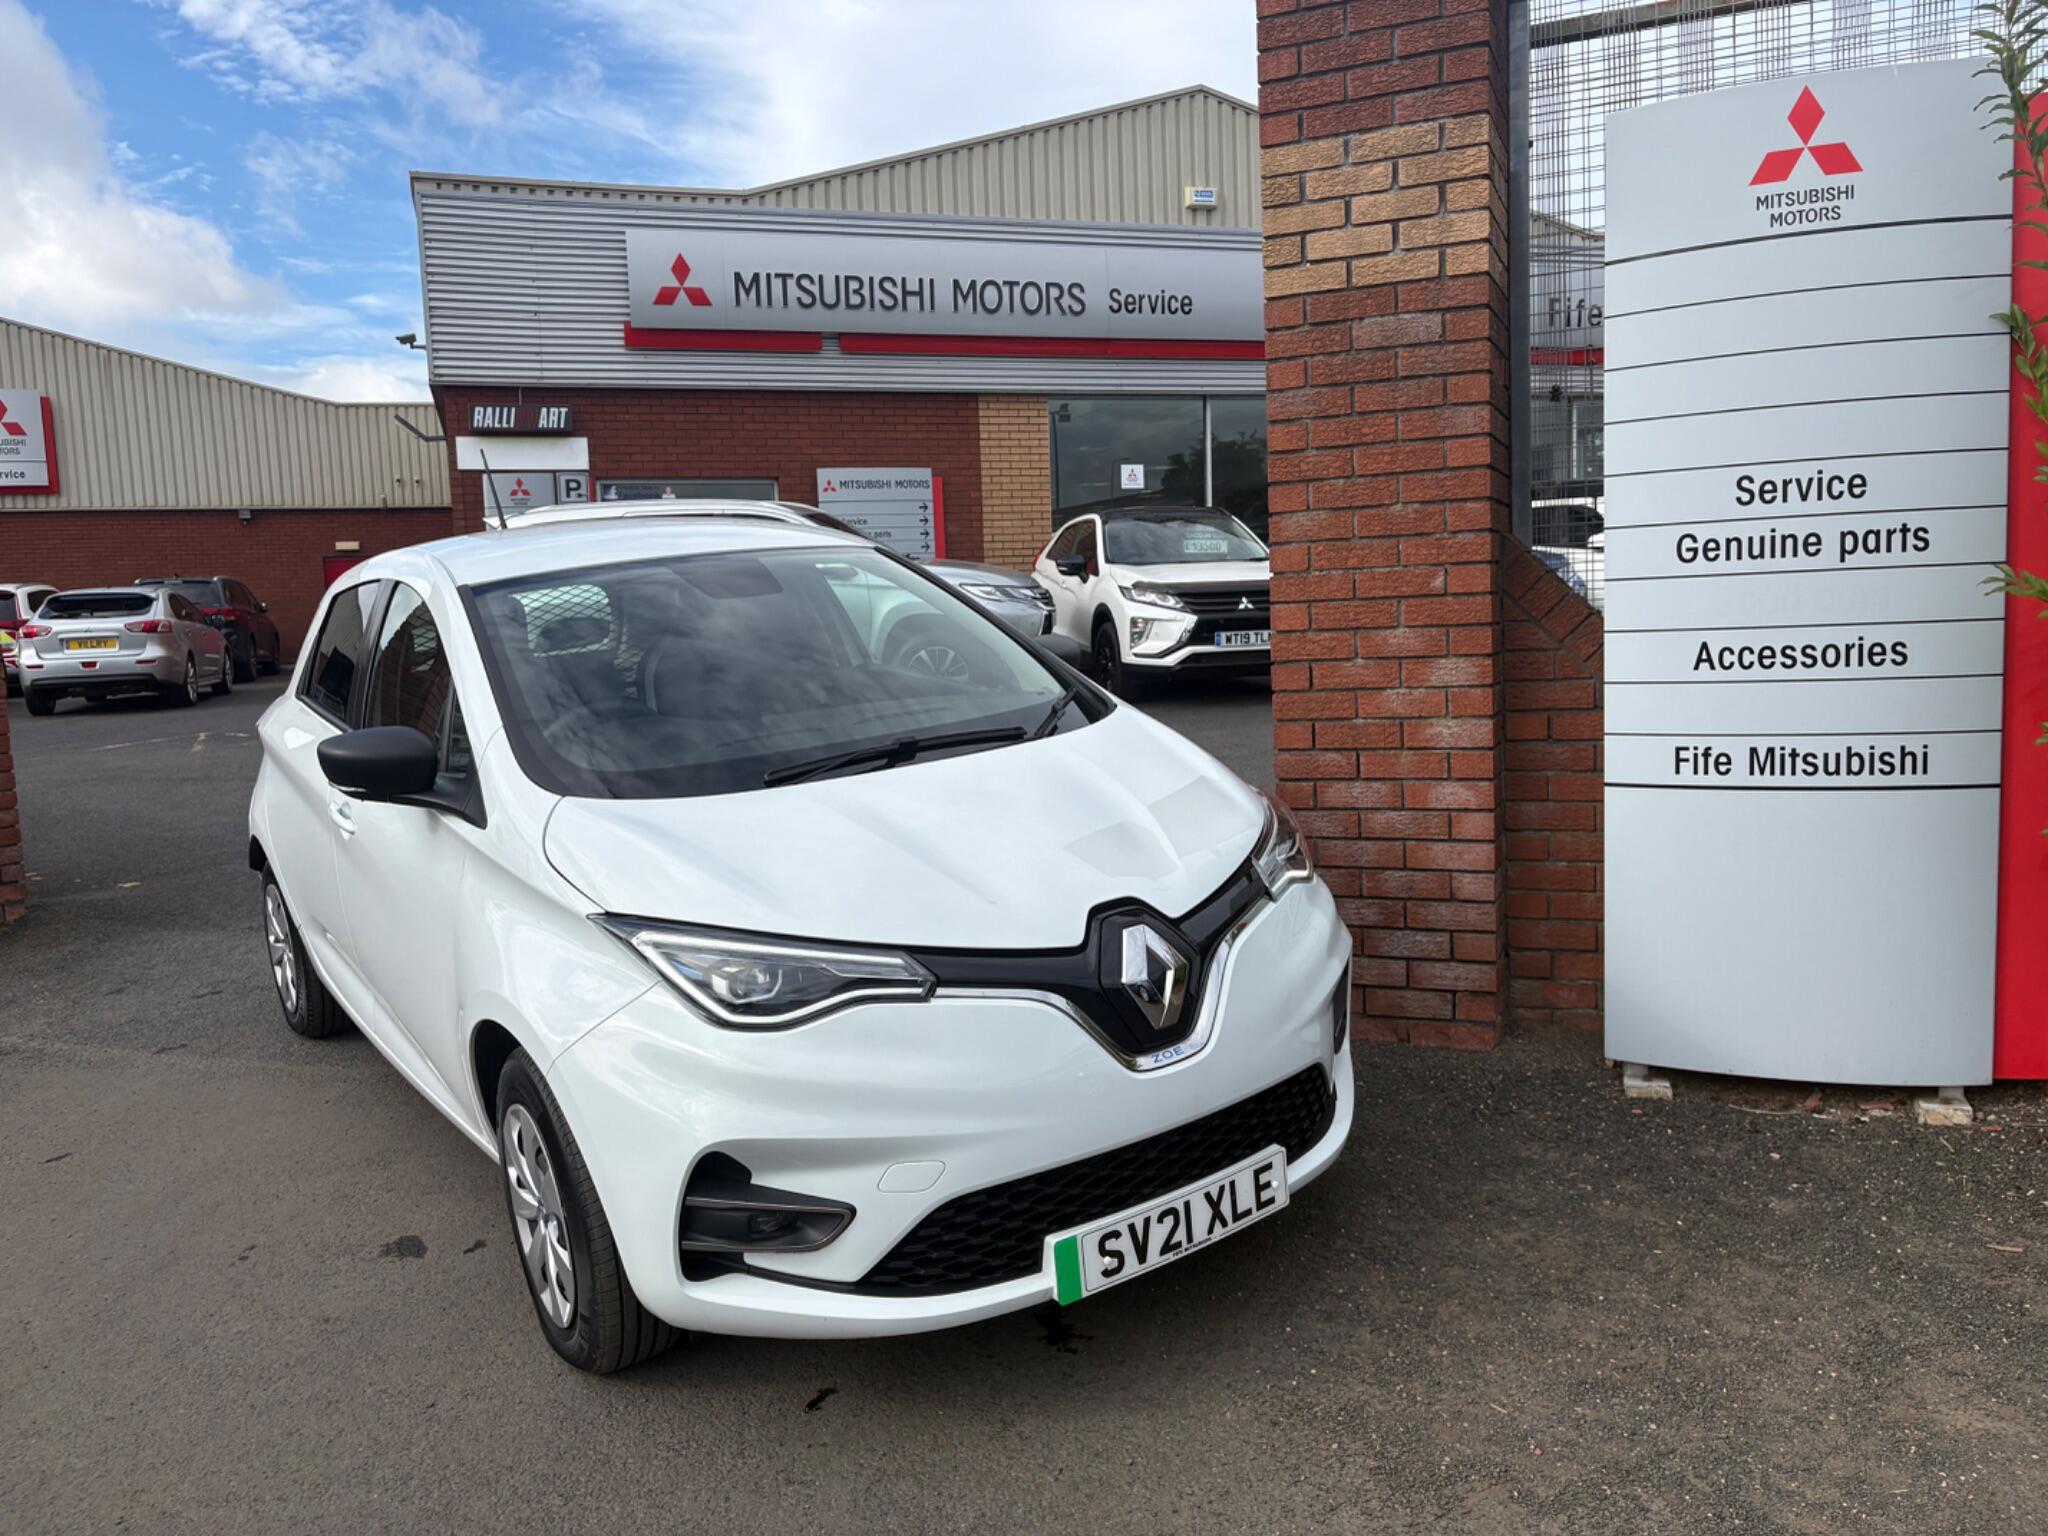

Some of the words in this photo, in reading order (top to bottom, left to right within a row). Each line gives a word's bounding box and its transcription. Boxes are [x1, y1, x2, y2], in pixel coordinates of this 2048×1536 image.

[1756, 184, 1855, 211] MITSUBISHI
[1770, 205, 1841, 228] MOTORS
[733, 270, 935, 312] MITSUBISHI
[952, 278, 1086, 317] MOTORS
[1108, 287, 1193, 315] Service
[1548, 297, 1603, 328] Fife
[473, 405, 516, 428] RALLI
[538, 406, 569, 429] ART
[839, 479, 892, 490] MITSUBISHI
[895, 479, 930, 490] MOTORS
[1735, 469, 1868, 507] Service
[1675, 528, 1823, 564] Genuine
[1839, 522, 1931, 563] parts
[1225, 632, 1250, 645] WT19
[1693, 636, 1909, 671] Accessories
[1674, 746, 1733, 776] Fife
[1748, 744, 1930, 776] Mitsubishi
[1151, 1046, 1185, 1064] ZOE
[1098, 1200, 1194, 1278] SV21
[1203, 1160, 1276, 1236] XLE
